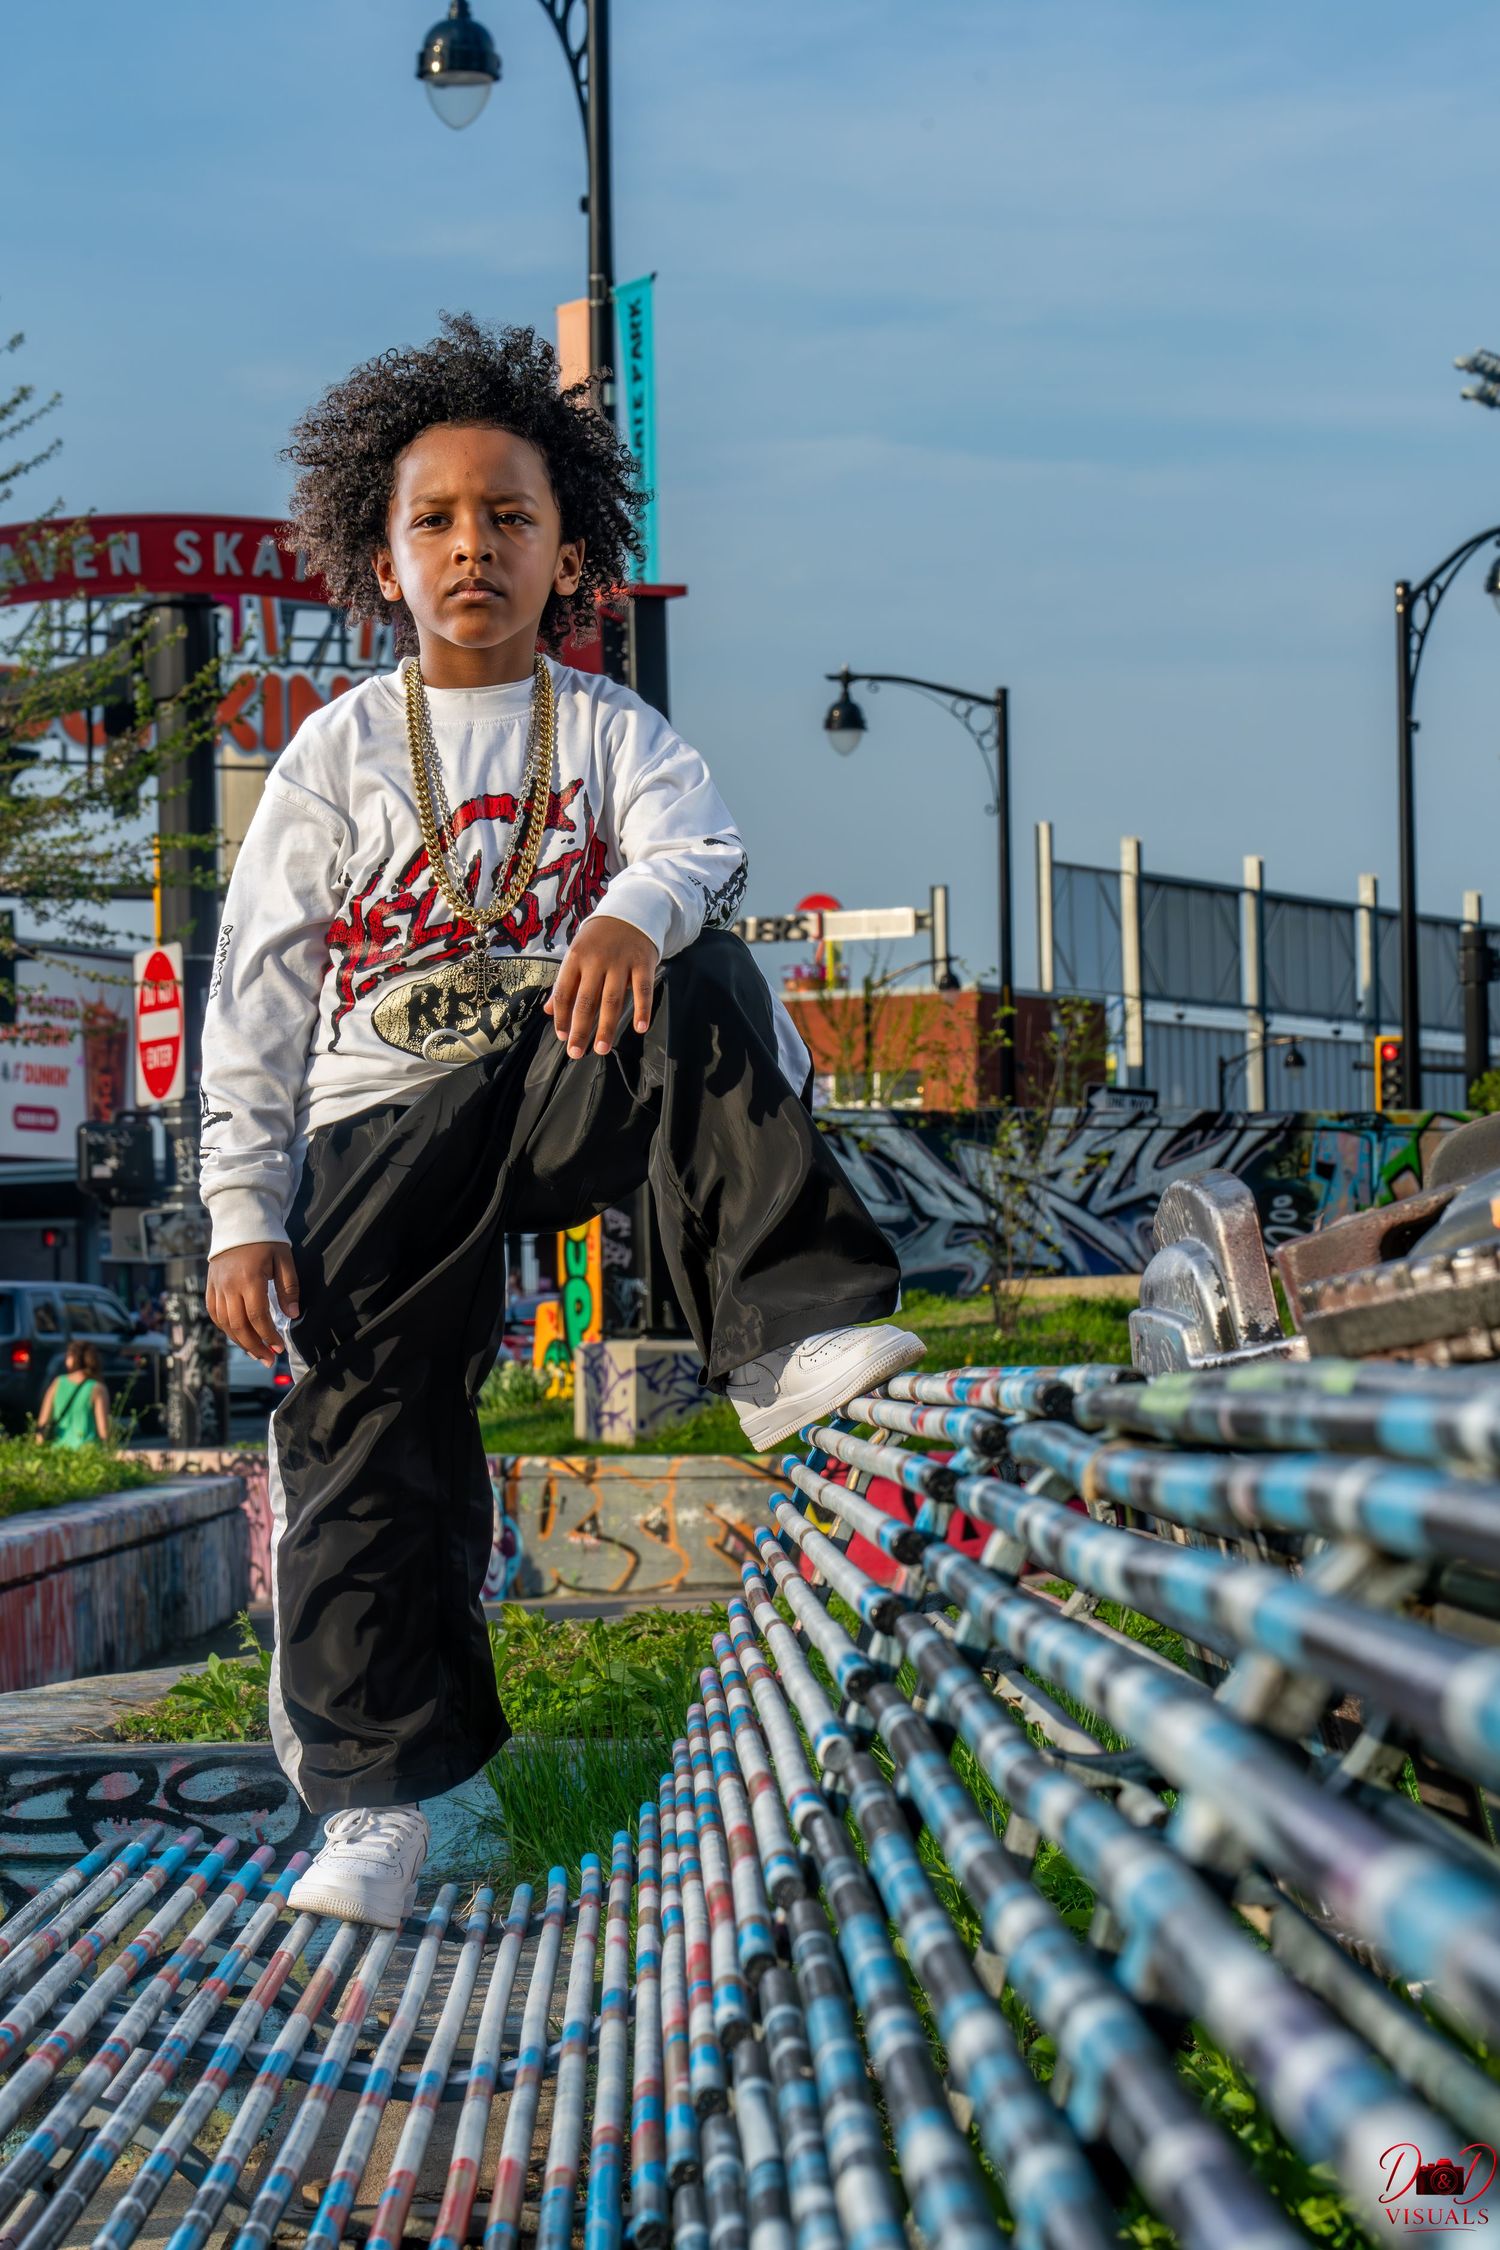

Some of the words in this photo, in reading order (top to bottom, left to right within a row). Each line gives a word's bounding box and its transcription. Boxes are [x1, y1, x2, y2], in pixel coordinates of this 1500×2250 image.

[627, 297, 643, 383] PARK
[143, 983, 156, 1007] DO
[157, 980, 175, 1004] NOT
[146, 1044, 173, 1070] ENTER
